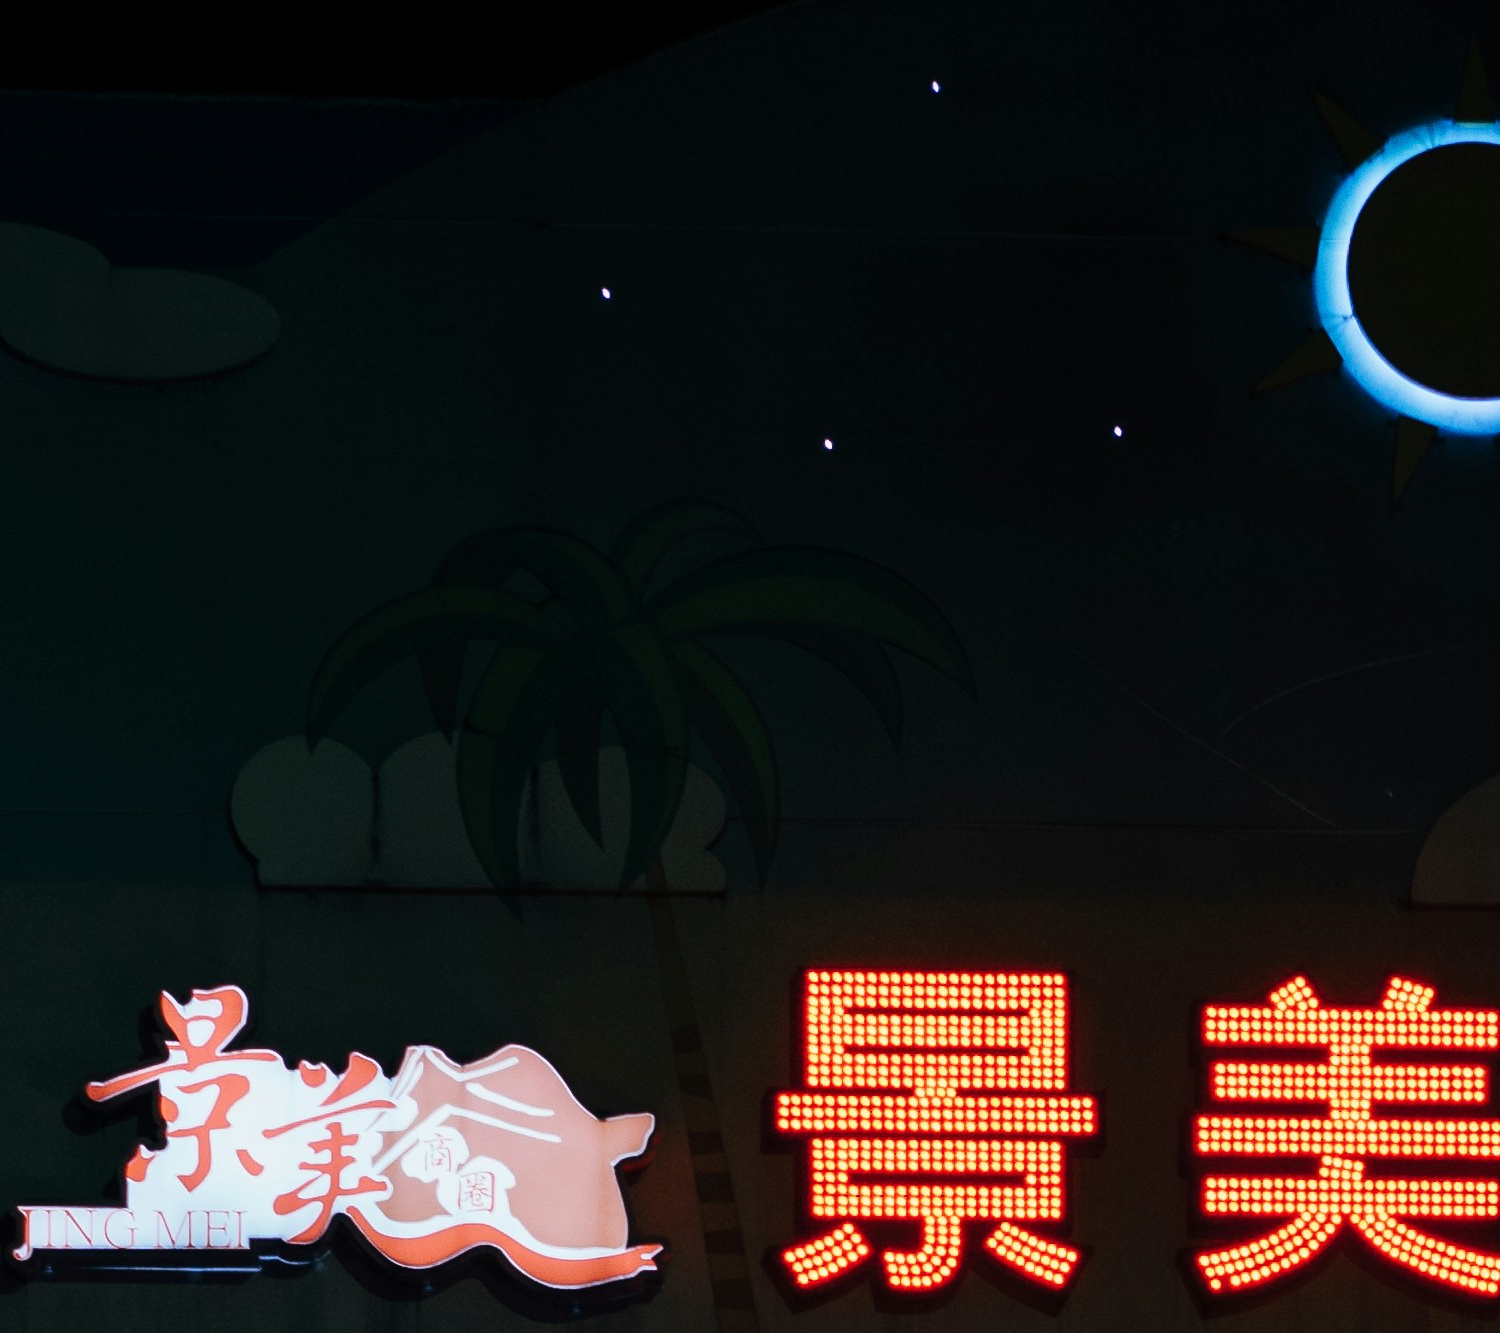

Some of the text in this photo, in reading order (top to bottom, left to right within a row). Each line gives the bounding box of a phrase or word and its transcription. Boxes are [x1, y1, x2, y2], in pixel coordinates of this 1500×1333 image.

[86, 985, 398, 1246] 景美
[422, 1134, 496, 1215] 商圈
[14, 1207, 250, 1260] JING MEI
